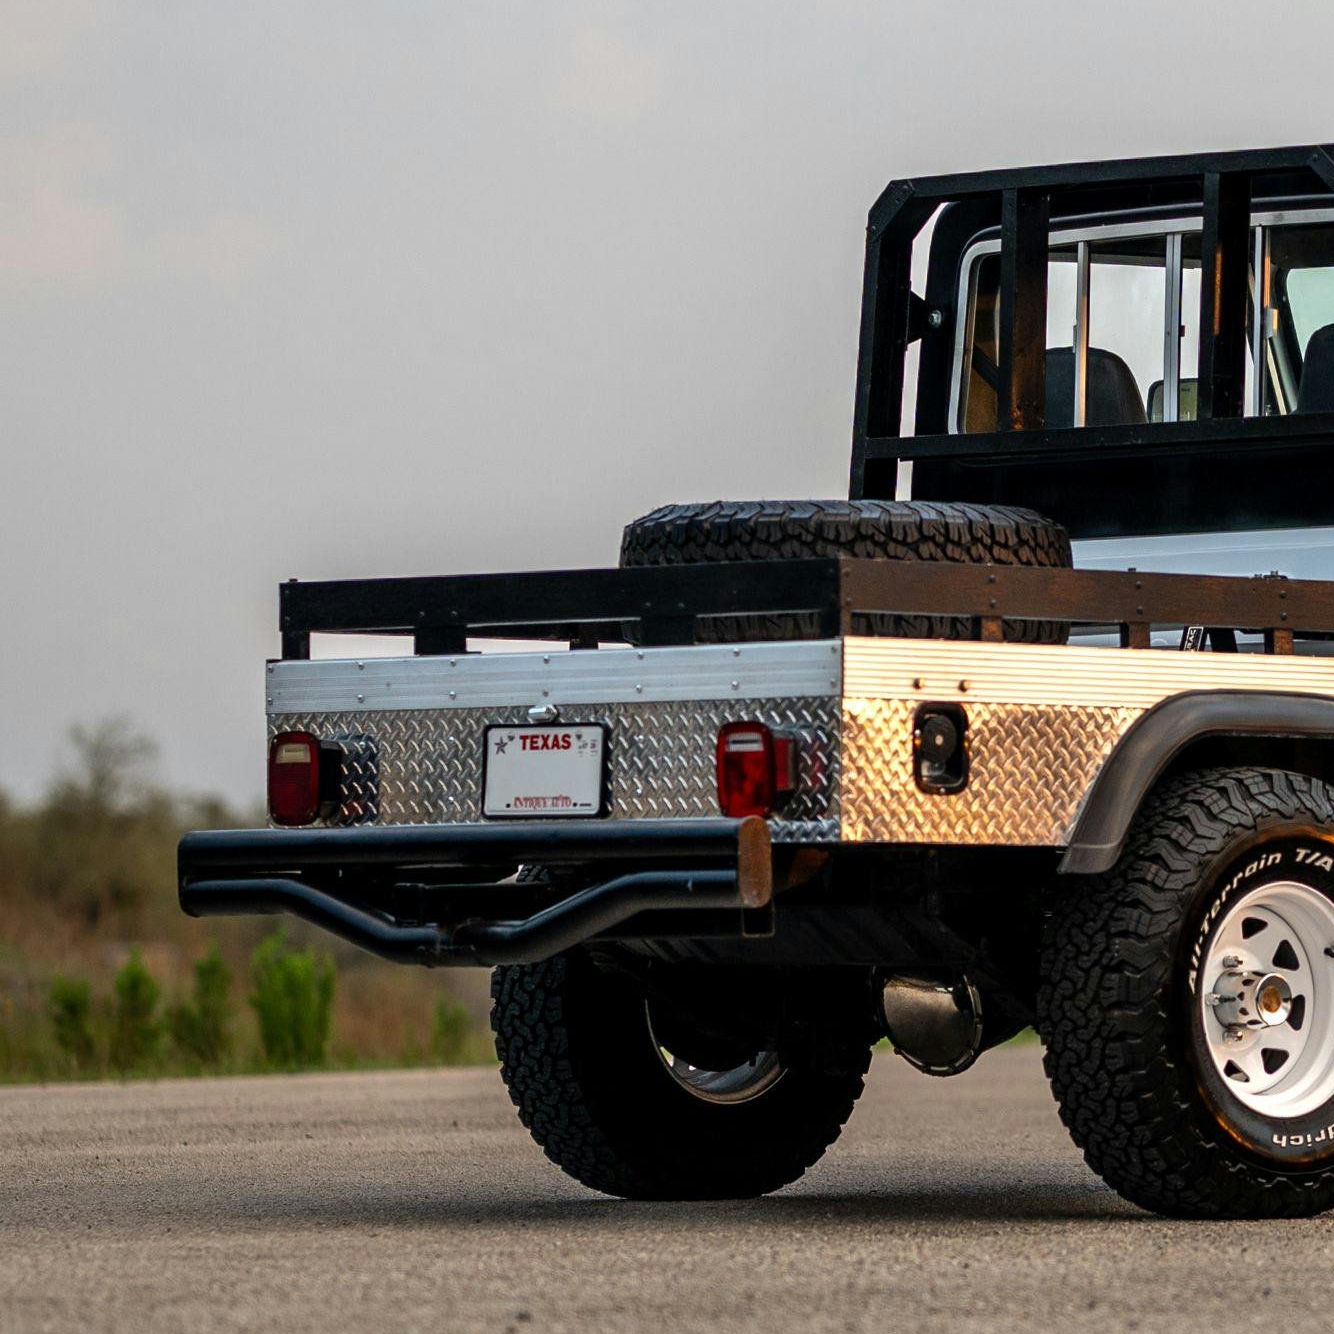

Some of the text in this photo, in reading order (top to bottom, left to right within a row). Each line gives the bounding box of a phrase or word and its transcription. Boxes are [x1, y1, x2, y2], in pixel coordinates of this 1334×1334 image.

[519, 733, 571, 751] TEXAS
[1188, 848, 1334, 995] All-Terrain T/A
